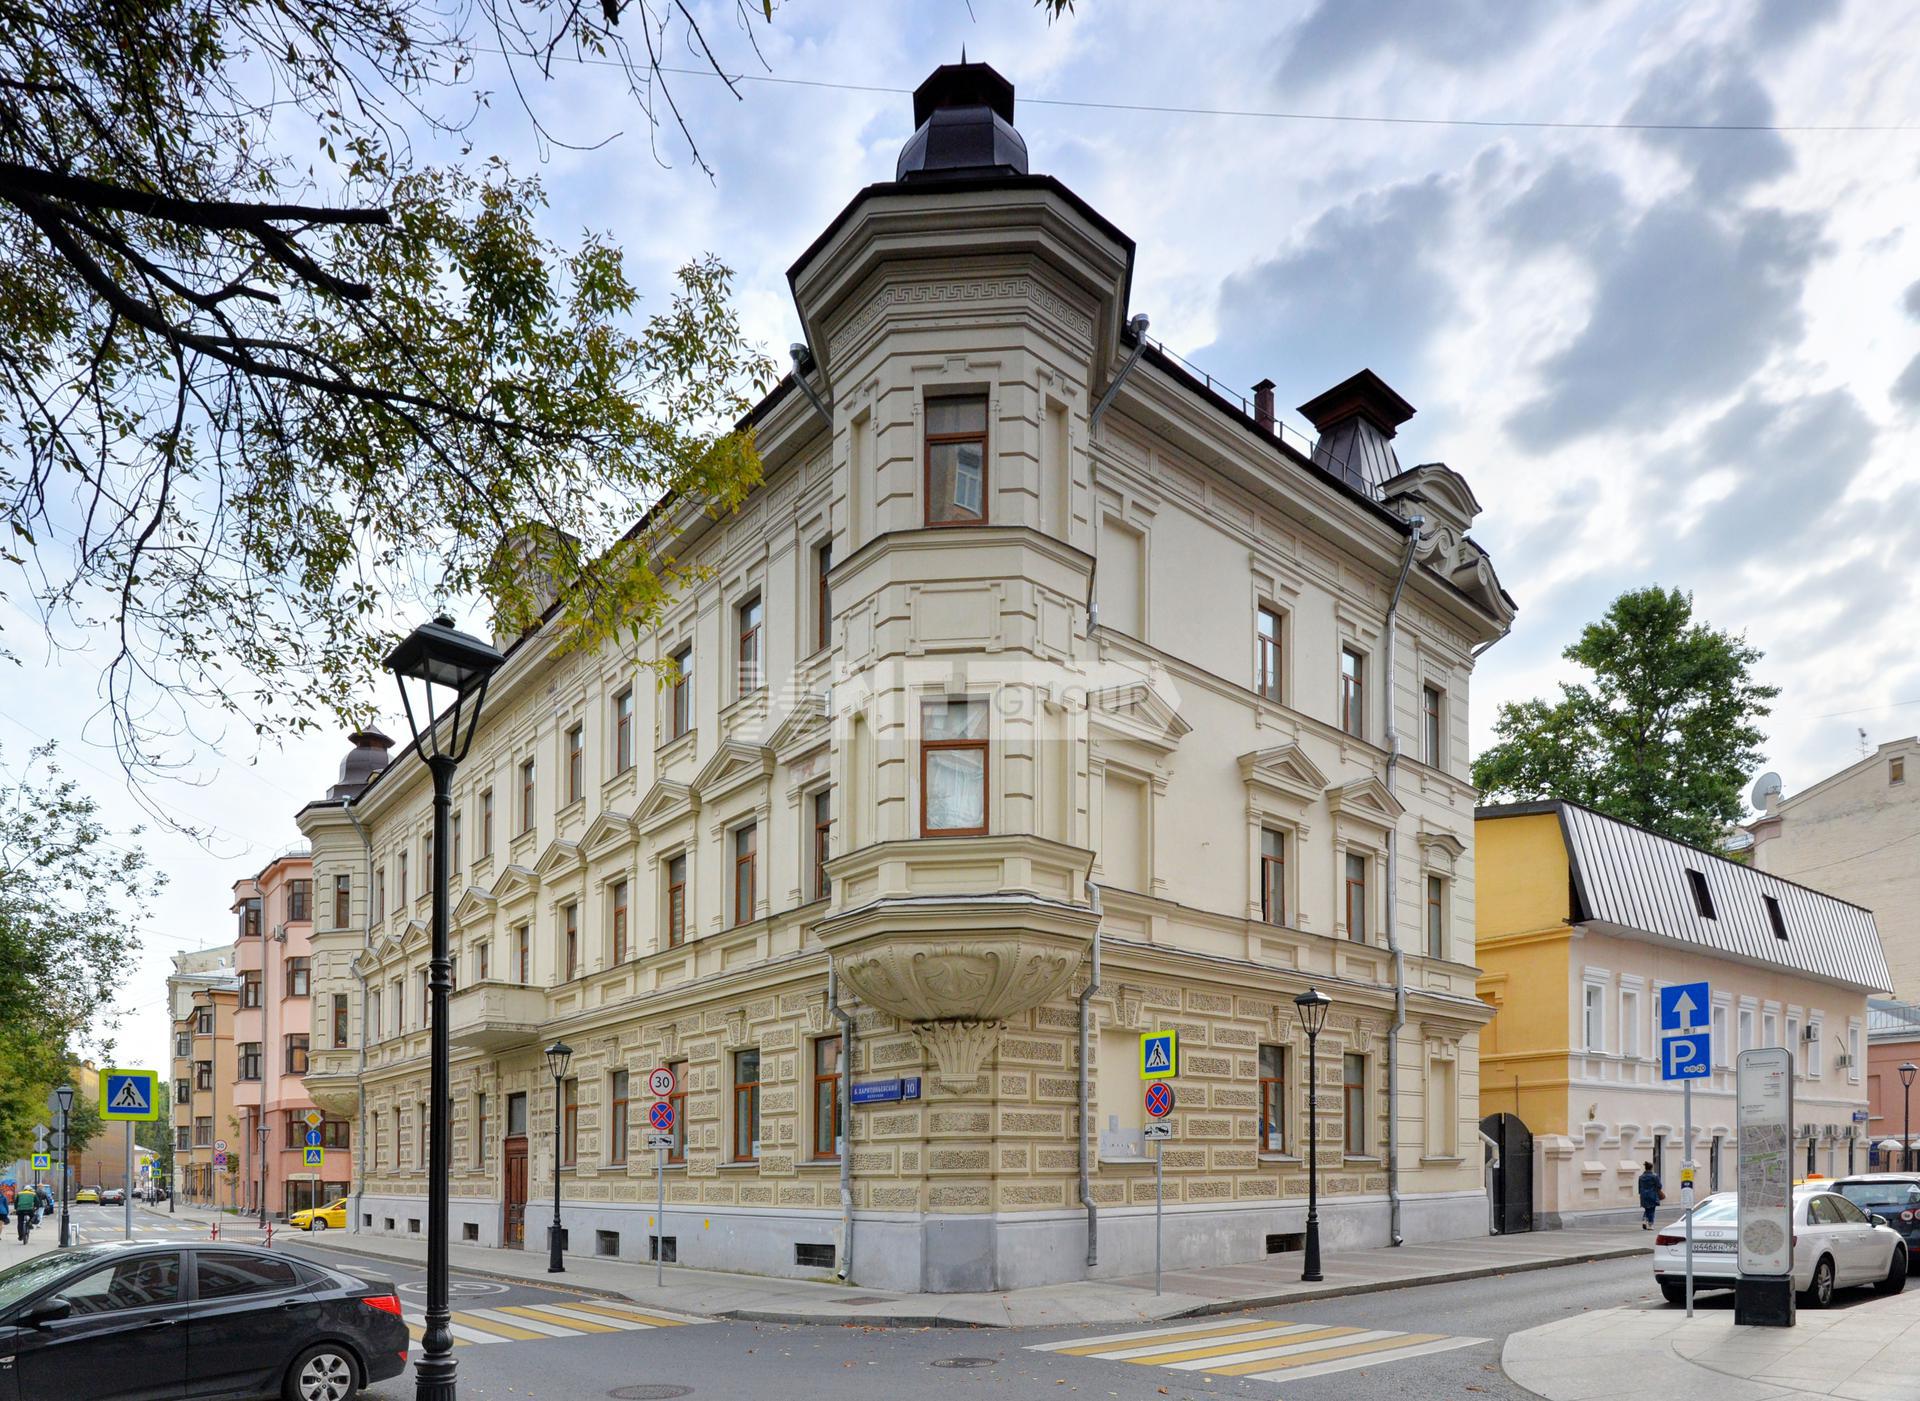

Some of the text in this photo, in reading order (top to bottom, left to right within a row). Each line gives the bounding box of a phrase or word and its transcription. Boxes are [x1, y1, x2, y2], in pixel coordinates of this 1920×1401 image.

[1670, 1040, 1696, 1075] P
[655, 1076, 670, 1088] 30
[906, 1083, 915, 1094] 10
